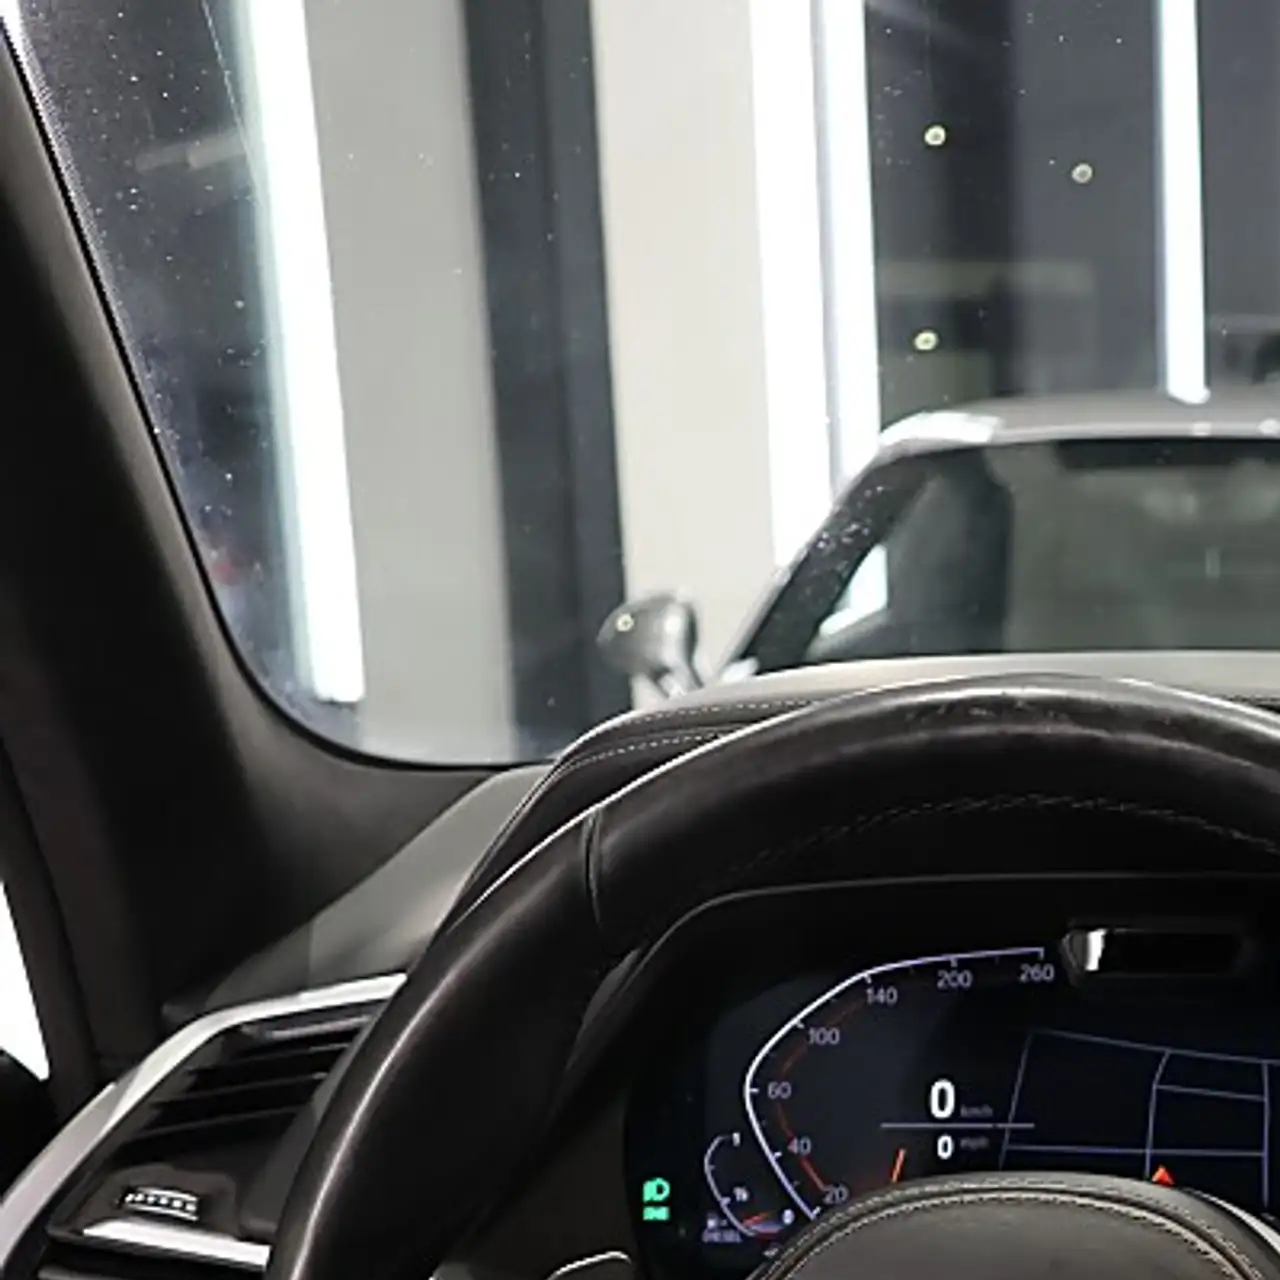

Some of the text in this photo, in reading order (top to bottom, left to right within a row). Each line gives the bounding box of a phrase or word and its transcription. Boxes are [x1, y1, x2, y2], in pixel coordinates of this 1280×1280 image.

[936, 968, 973, 989] 200
[1019, 963, 1055, 983] 260
[866, 986, 898, 1004] 140
[808, 1027, 840, 1046] 100
[767, 1081, 792, 1099] 60
[929, 1078, 956, 1119] 0
[788, 1137, 812, 1155] 40
[936, 1135, 953, 1159] 0
[825, 1184, 849, 1202] 20
